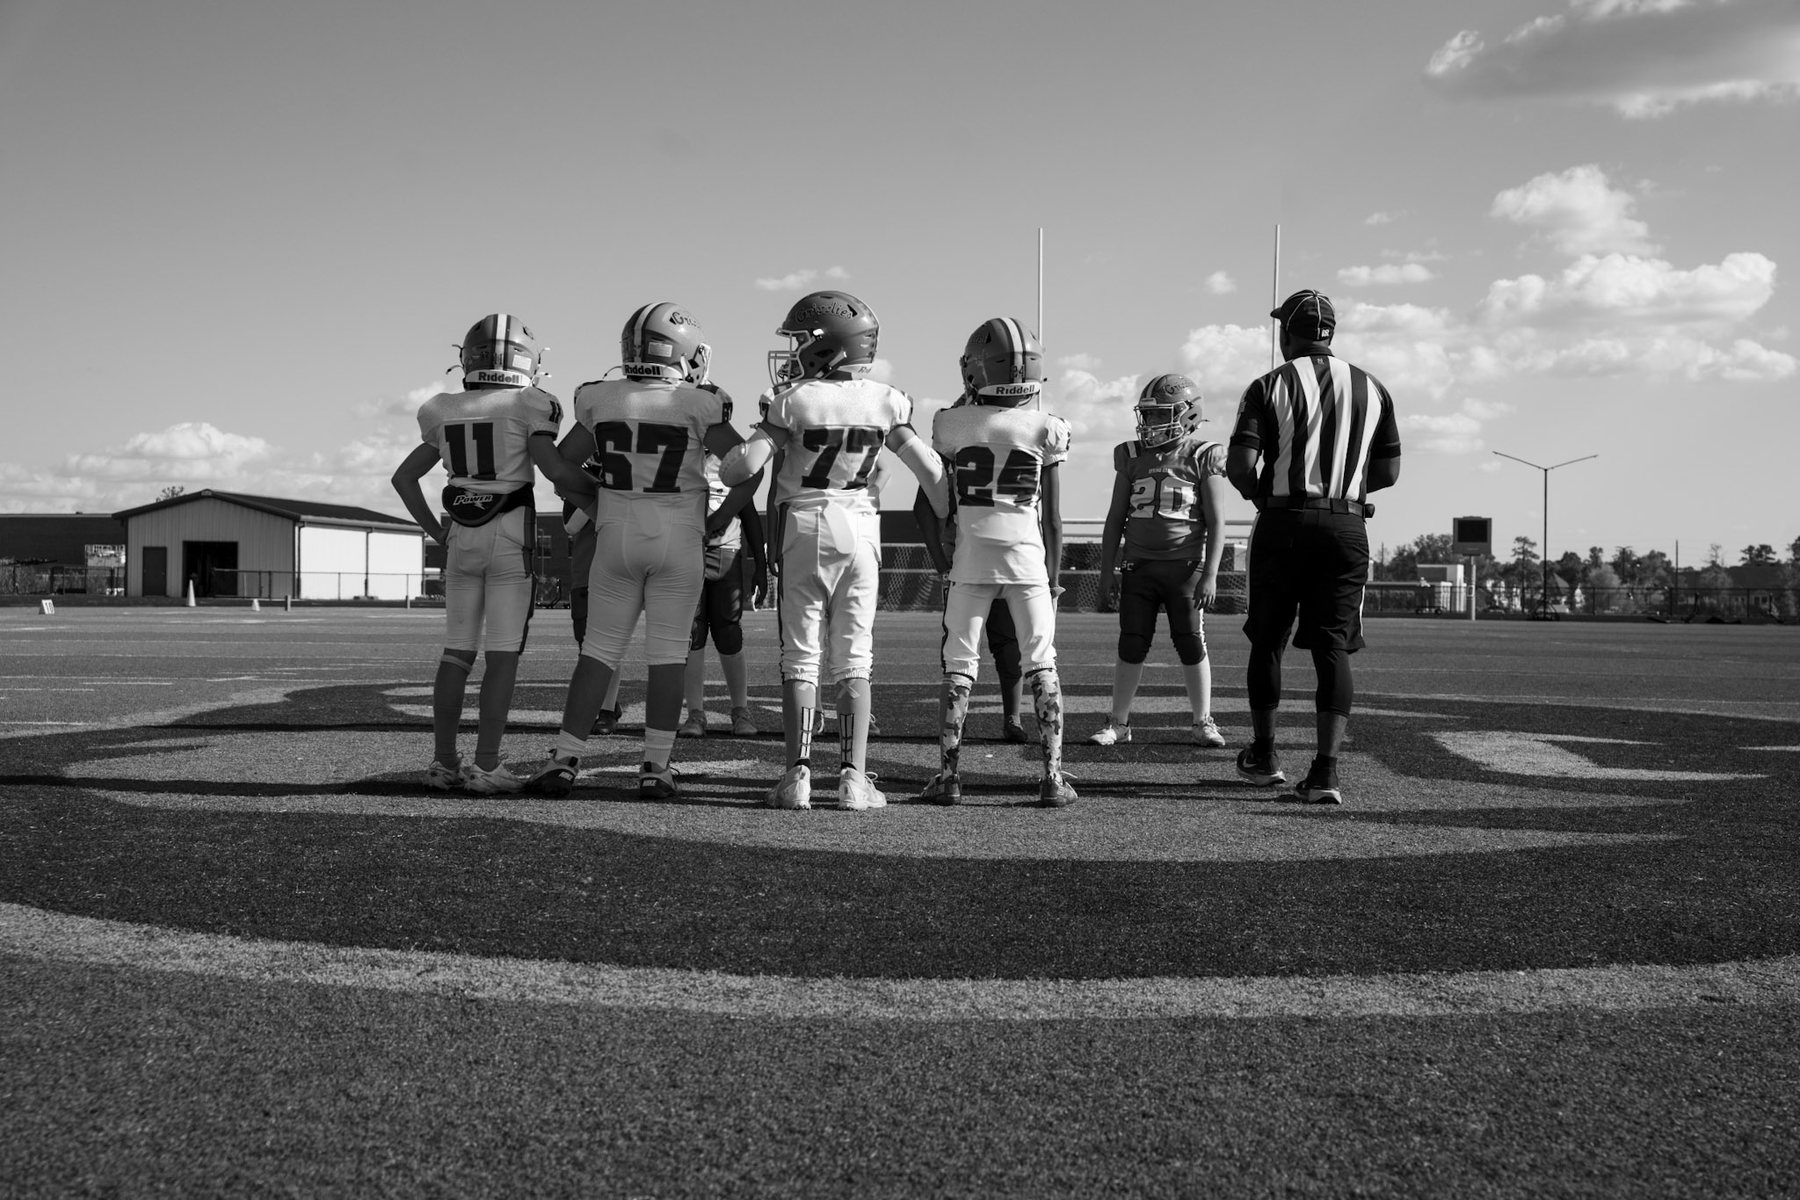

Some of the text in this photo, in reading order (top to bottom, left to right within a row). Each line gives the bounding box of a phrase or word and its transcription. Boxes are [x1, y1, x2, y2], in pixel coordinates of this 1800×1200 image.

[478, 371, 519, 384] Riddell
[624, 364, 661, 376] Riddell
[995, 384, 1035, 395] Riddell
[444, 422, 497, 480] 11
[594, 421, 689, 493] 67
[801, 428, 885, 490] 77
[1129, 476, 1197, 521] 20
